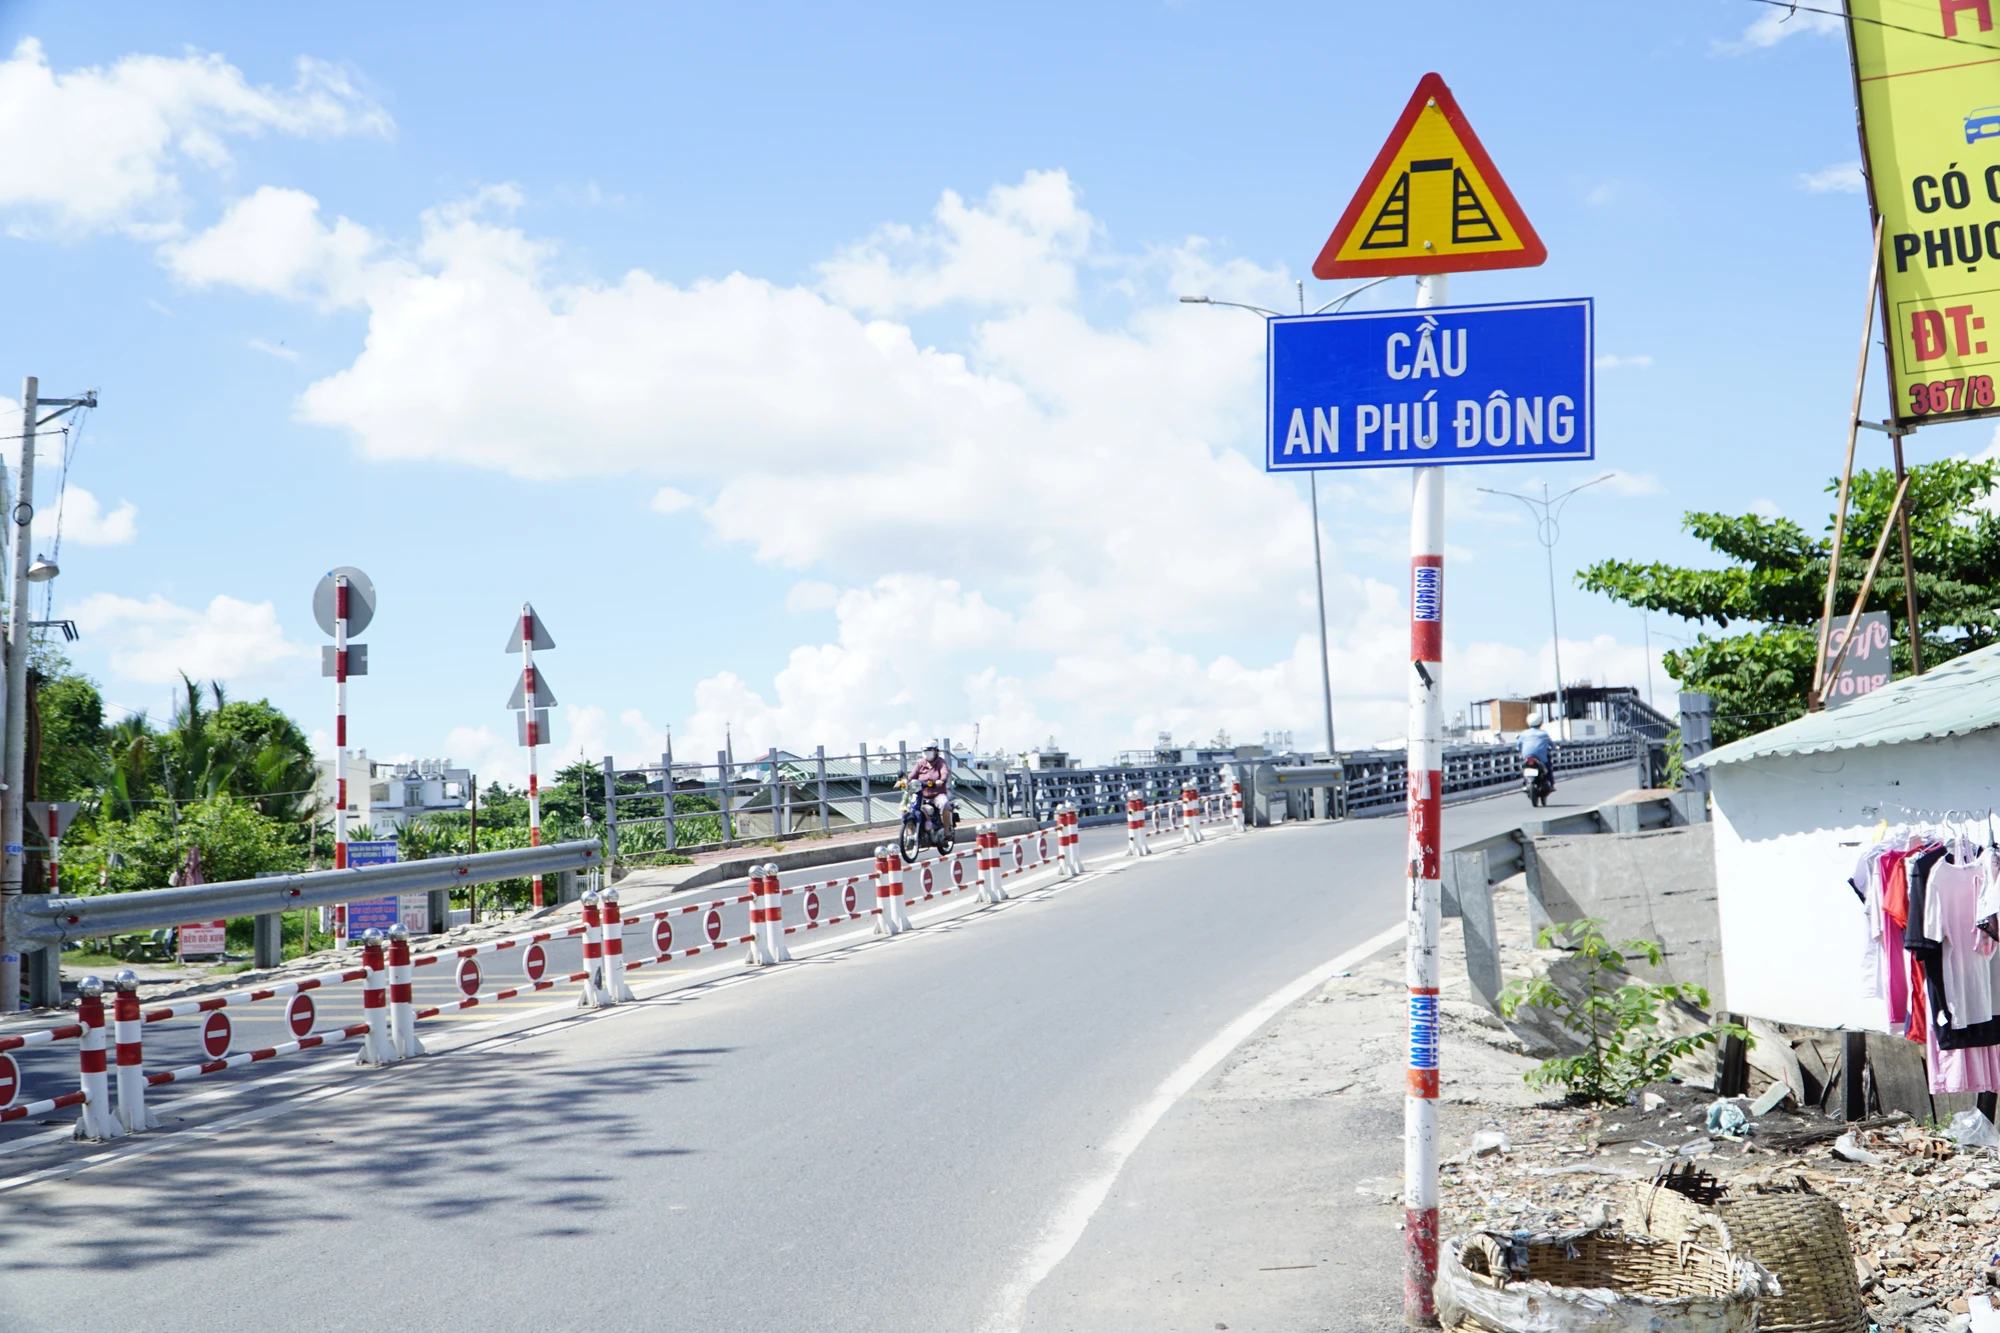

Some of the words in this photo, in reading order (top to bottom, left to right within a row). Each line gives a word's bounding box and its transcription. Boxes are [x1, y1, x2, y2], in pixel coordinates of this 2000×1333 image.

[1912, 162, 1971, 214] CÓ
[1387, 315, 1468, 380] CẦU
[1911, 305, 1988, 363] ĐT:
[1283, 406, 1340, 455] AN
[1356, 389, 1439, 452] PHÚ
[1453, 389, 1576, 448] ĐÔNG
[1909, 375, 1996, 416] 367/8
